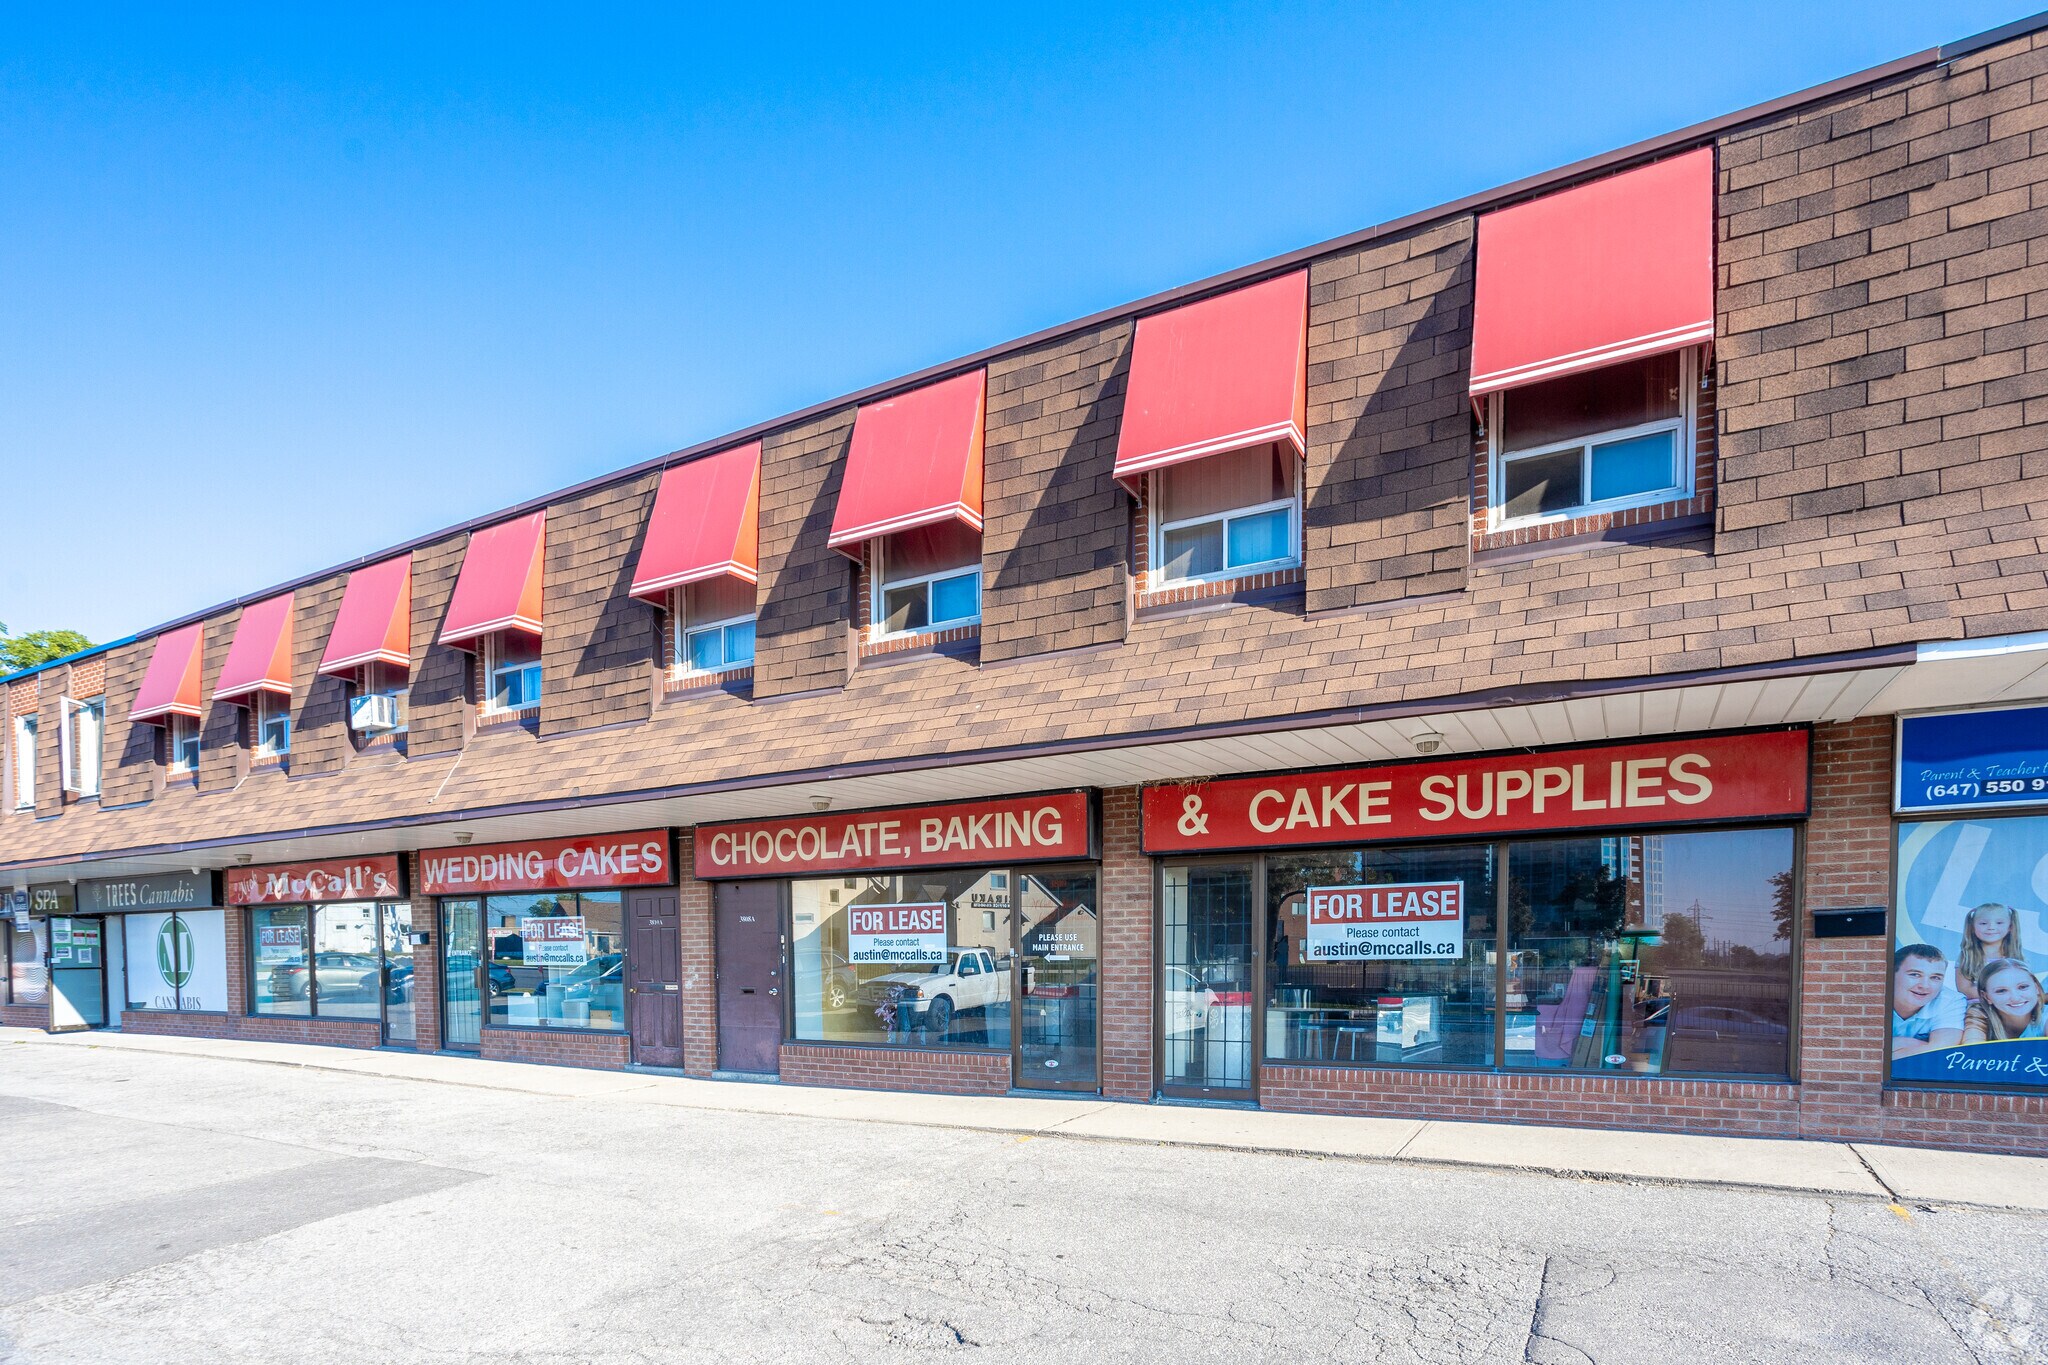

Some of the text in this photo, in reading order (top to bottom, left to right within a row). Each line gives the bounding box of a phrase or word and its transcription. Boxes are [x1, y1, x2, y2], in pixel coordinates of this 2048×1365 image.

[1920, 767, 1965, 782] Parent
[1966, 768, 1981, 780] &
[1986, 761, 2040, 777] Teacher
[1177, 753, 1713, 837] & CAKE SUPPLIES
[1926, 778, 2048, 801] (647) 550 9
[710, 806, 1063, 866] CHOCOLATE, BAKING
[424, 842, 663, 884] WEDDING CAKES
[267, 865, 386, 896] McCall's
[34, 888, 59, 911] SPA
[106, 880, 194, 907] TREES Cannabis
[1313, 890, 1457, 919] FOR LEASE
[524, 921, 583, 939] FOR LEASE
[852, 909, 943, 931] FOR LEASE
[261, 929, 300, 943] FOR LEASE
[873, 937, 920, 947] Please contact
[1064, 933, 1078, 941] USE
[1347, 926, 1420, 938] Please contact
[853, 949, 942, 960] austin@mccalls.ca
[1032, 943, 1084, 951] MAIN ENTRANCE
[1313, 941, 1455, 956] austin@mccalls.ca
[525, 953, 584, 963] austin@mccalls.ca
[1946, 1051, 2048, 1077] Parent &
